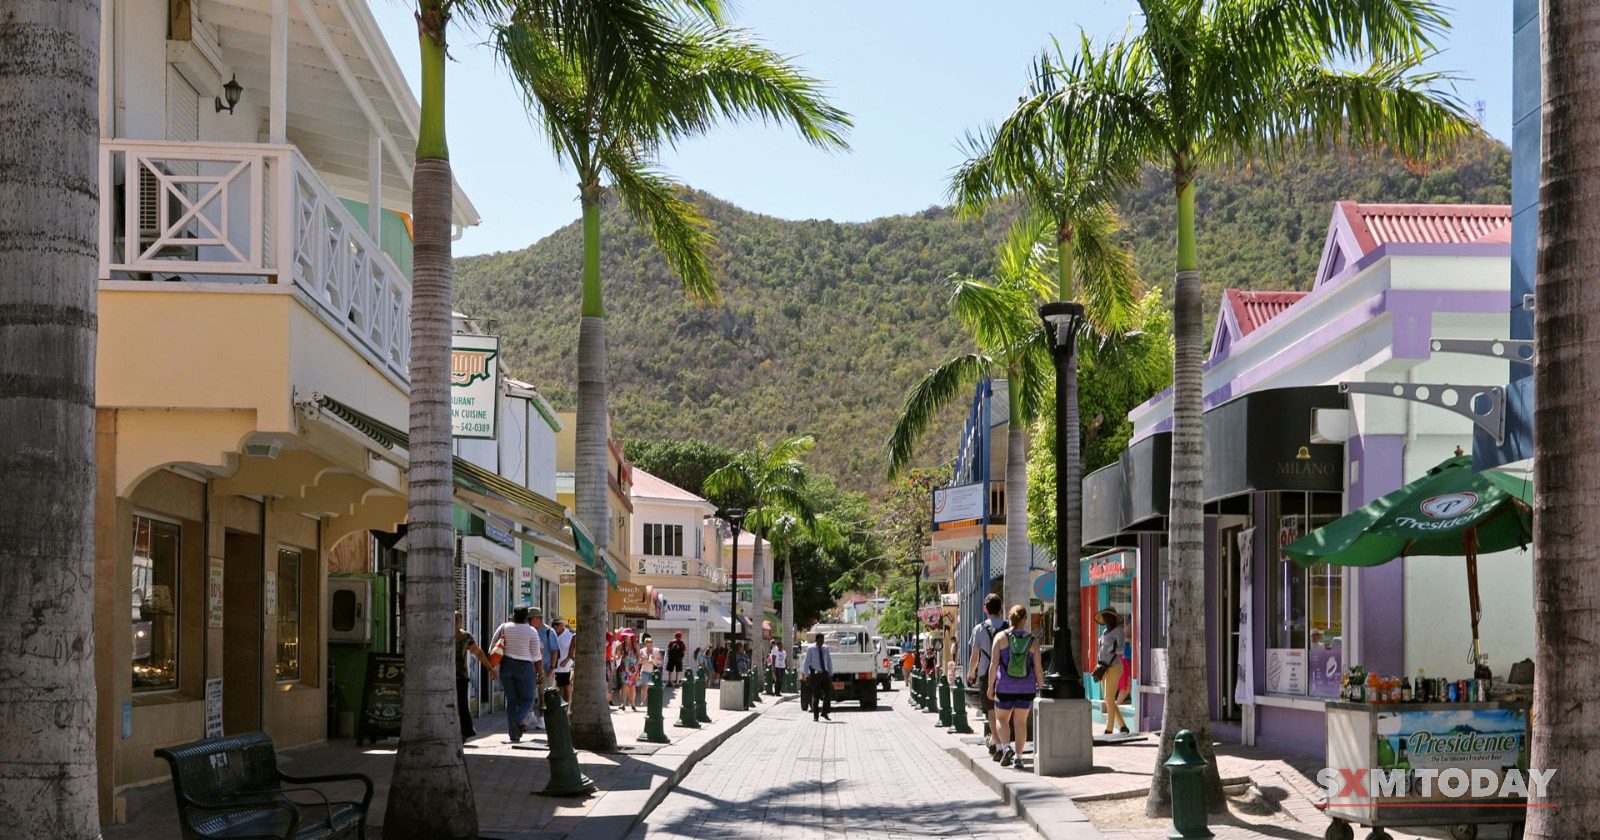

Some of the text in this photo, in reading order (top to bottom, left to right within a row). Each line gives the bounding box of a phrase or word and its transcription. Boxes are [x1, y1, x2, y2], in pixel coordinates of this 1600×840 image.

[461, 410, 487, 419] CUISINE
[1276, 462, 1335, 475] MILANO
[666, 603, 691, 612] AVENUE
[1408, 731, 1516, 754] Presidente
